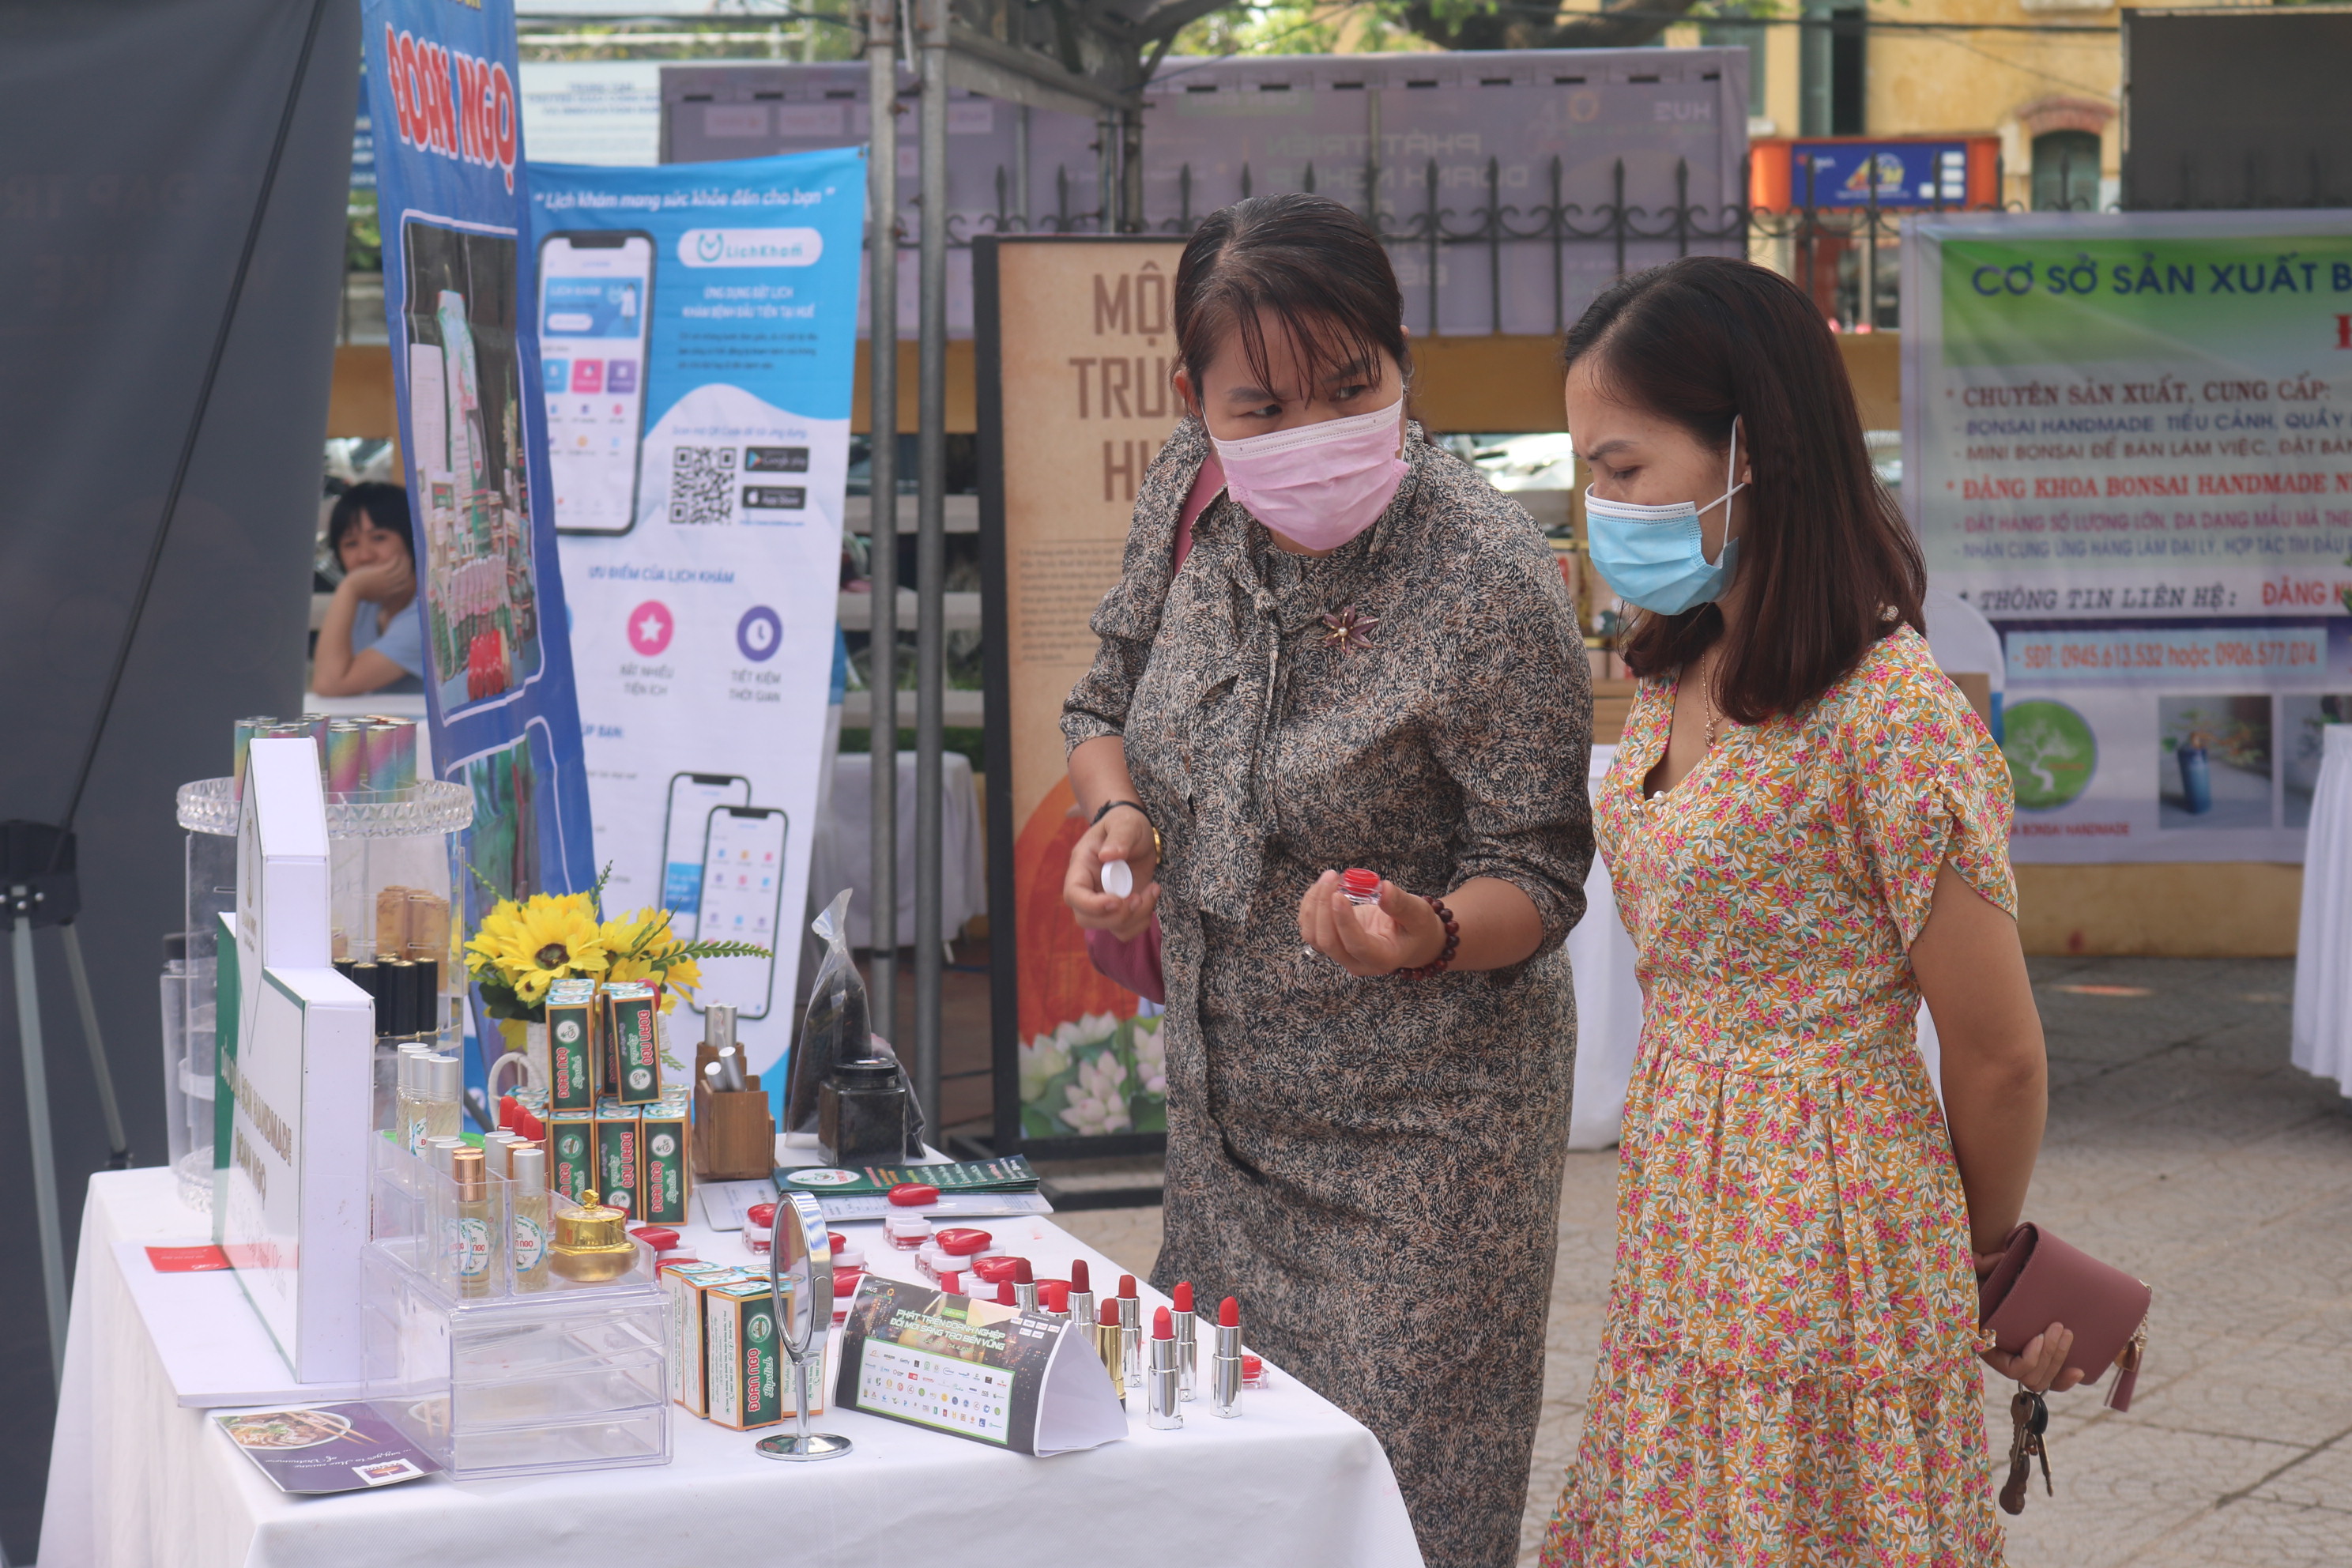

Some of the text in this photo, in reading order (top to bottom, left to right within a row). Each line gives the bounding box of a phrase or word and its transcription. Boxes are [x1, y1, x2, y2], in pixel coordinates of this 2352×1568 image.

[453, 50, 517, 196] NGỌ
[545, 193, 576, 213] Lịch
[619, 195, 659, 211] mang
[663, 190, 689, 207] sức
[730, 187, 760, 206] đến
[762, 189, 791, 205] cho
[792, 189, 822, 209] bạn
[1972, 260, 2034, 296] CƠ
[2047, 252, 2098, 296] SỞ
[2112, 251, 2196, 295] SẢN
[2208, 250, 2319, 293] XUẤT
[1093, 260, 1178, 346] MỘ
[1069, 356, 1185, 419] TRU
[1963, 379, 2060, 408] CHUYÊN
[2067, 377, 2114, 405] SẢN
[2203, 379, 2269, 403] CUNG
[1967, 418, 2037, 435] BONSAI
[2041, 415, 2155, 434] HANDMADE
[1966, 446, 2009, 461] MINI
[2015, 443, 2084, 461] BONSAI
[2034, 477, 2099, 499] KHOA
[2105, 475, 2190, 498] BONSAI
[2198, 473, 2328, 496] HANDMADE
[1978, 584, 2058, 612] THÔNG
[2067, 587, 2113, 609] TIN
[2121, 582, 2185, 609] LIÊN
[2168, 642, 2211, 670] hoặc
[638, 1009, 654, 1066] ĐOAN NGỌ
[556, 1046, 571, 1099] ĐOAN NGỌ
[620, 1132, 634, 1189] ĐOAN NGỌ
[650, 1160, 665, 1213] ĐOAN NGỌ
[890, 1316, 905, 1327] ĐỔI
[920, 1324, 944, 1337] SÁNG
[944, 1329, 963, 1343] TẠO
[962, 1333, 981, 1346] BỀN
[981, 1337, 1006, 1351] VỮNG
[896, 1308, 1006, 1340] PHÁT TRIỂN DOANH NGHIỆP
[748, 1348, 761, 1412] ĐOAN NGỌ
[763, 1355, 776, 1398] Lipstick
